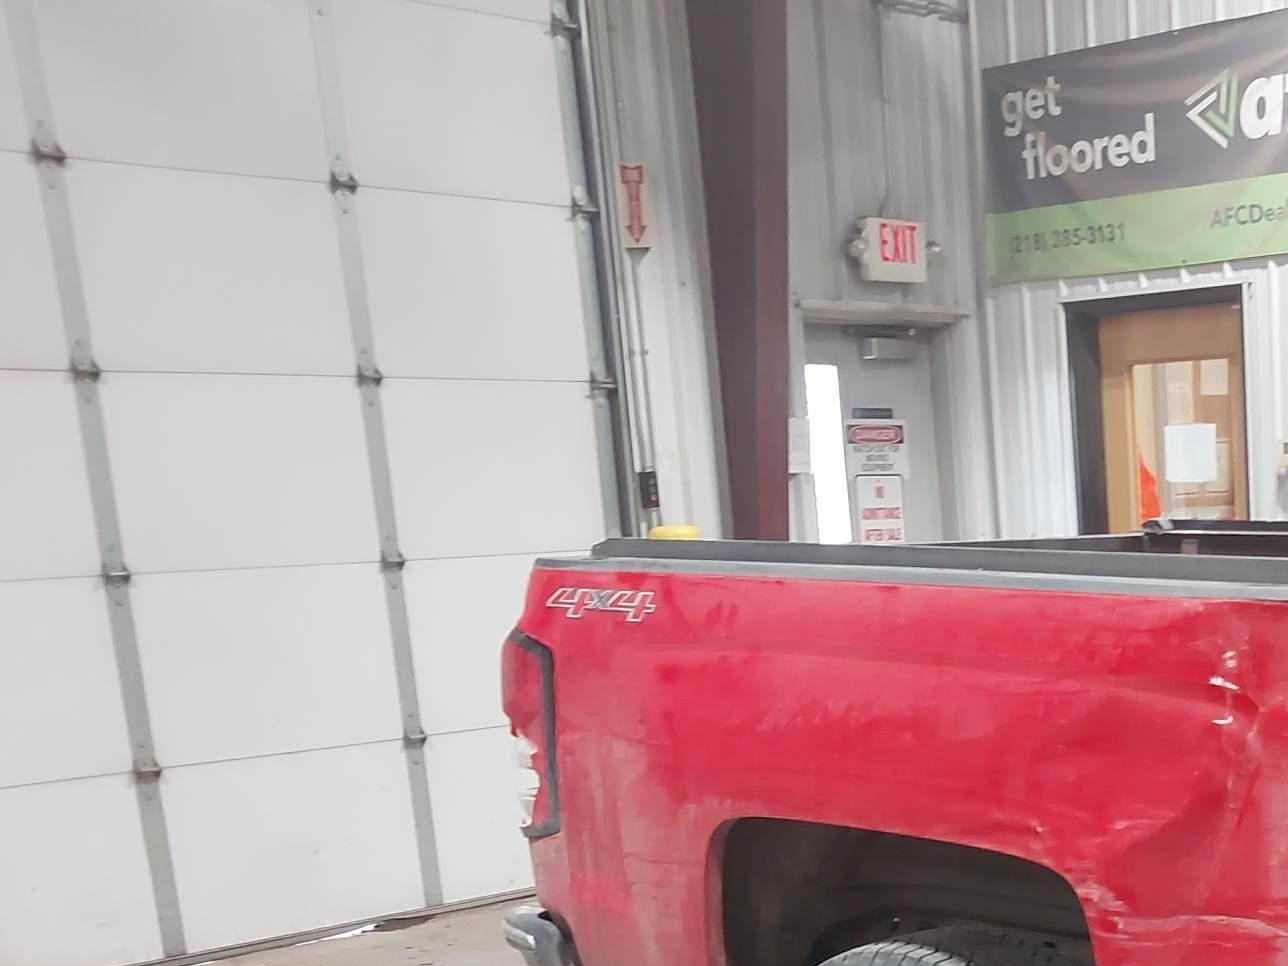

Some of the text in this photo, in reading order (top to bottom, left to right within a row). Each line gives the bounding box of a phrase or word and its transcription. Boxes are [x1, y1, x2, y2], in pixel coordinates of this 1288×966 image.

[1001, 76, 1061, 137] get
[1021, 113, 1156, 180] floored
[880, 222, 918, 264] EXIT
